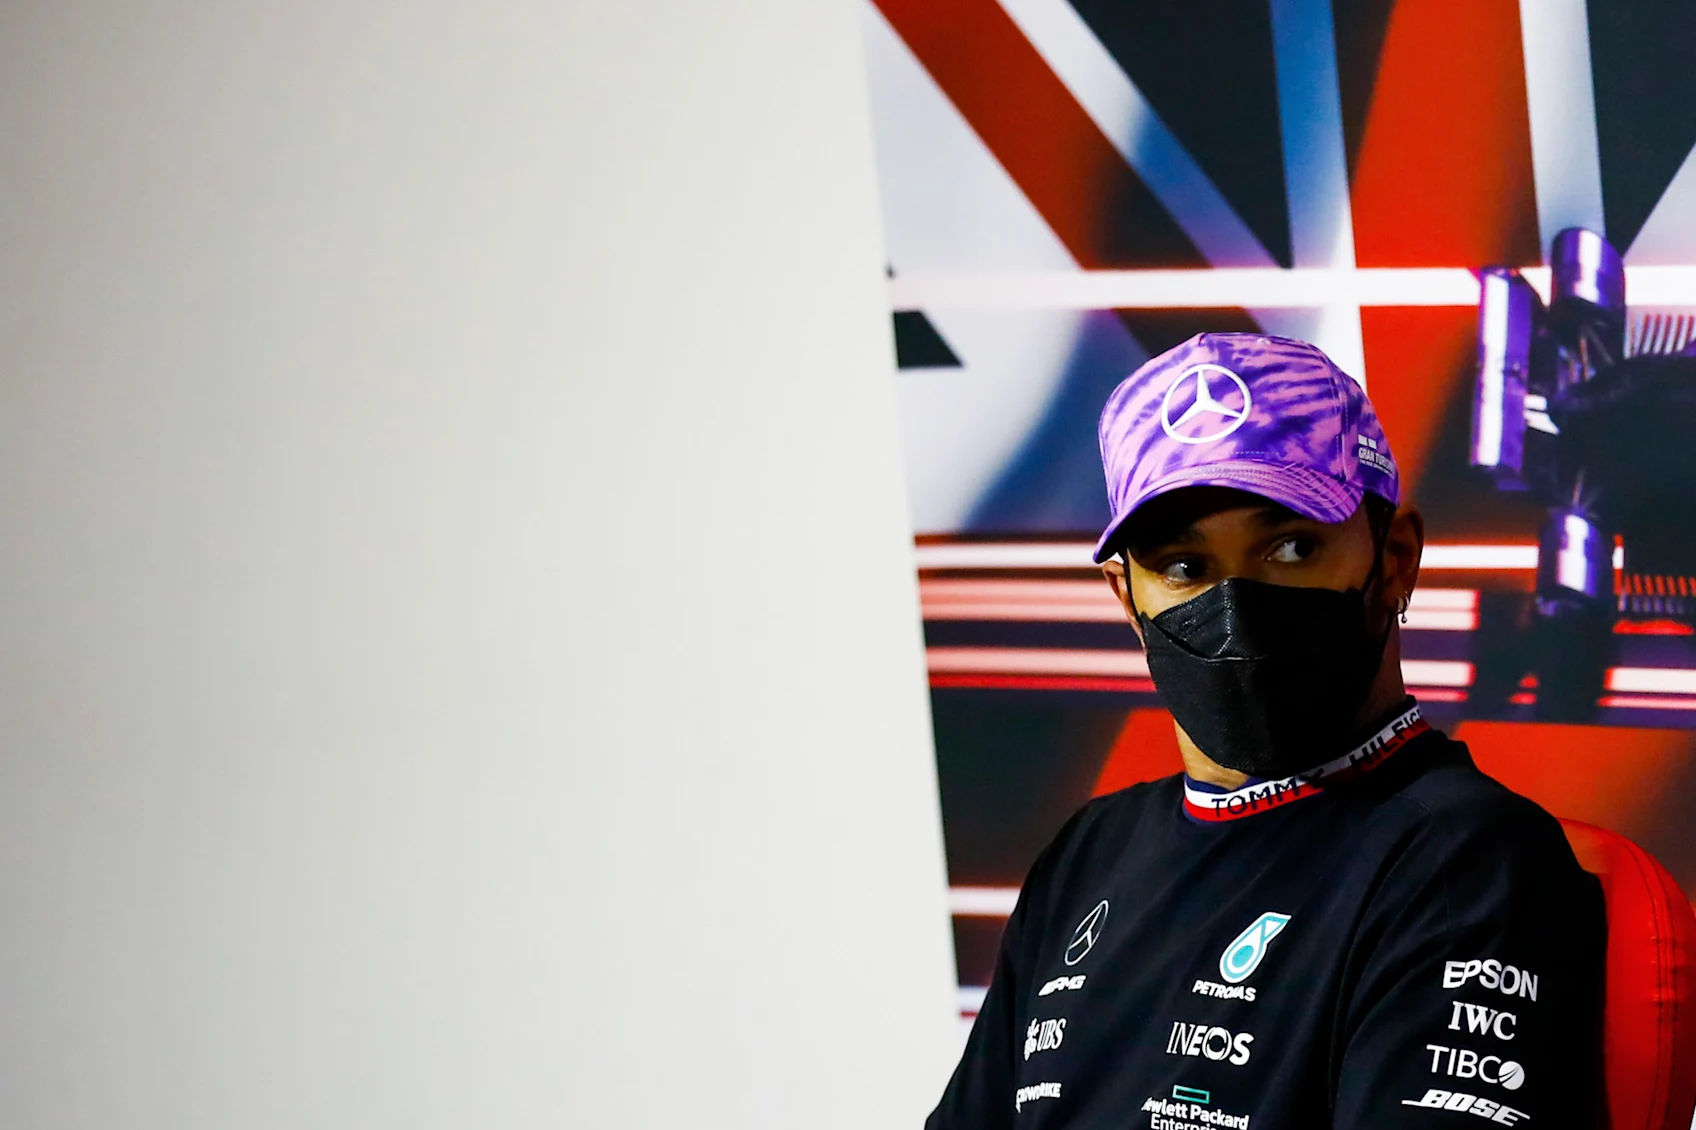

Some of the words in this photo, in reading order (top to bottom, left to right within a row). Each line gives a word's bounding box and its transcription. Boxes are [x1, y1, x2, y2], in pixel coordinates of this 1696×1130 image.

[1211, 768, 1325, 818] TOMMY
[1442, 958, 1538, 1003] EPSON
[1036, 1018, 1067, 1052] UBS
[1447, 1000, 1517, 1041] IWC
[1166, 1021, 1255, 1066] INEOS
[1426, 1043, 1526, 1091] TIBCO
[1401, 1089, 1531, 1127] BOSE
